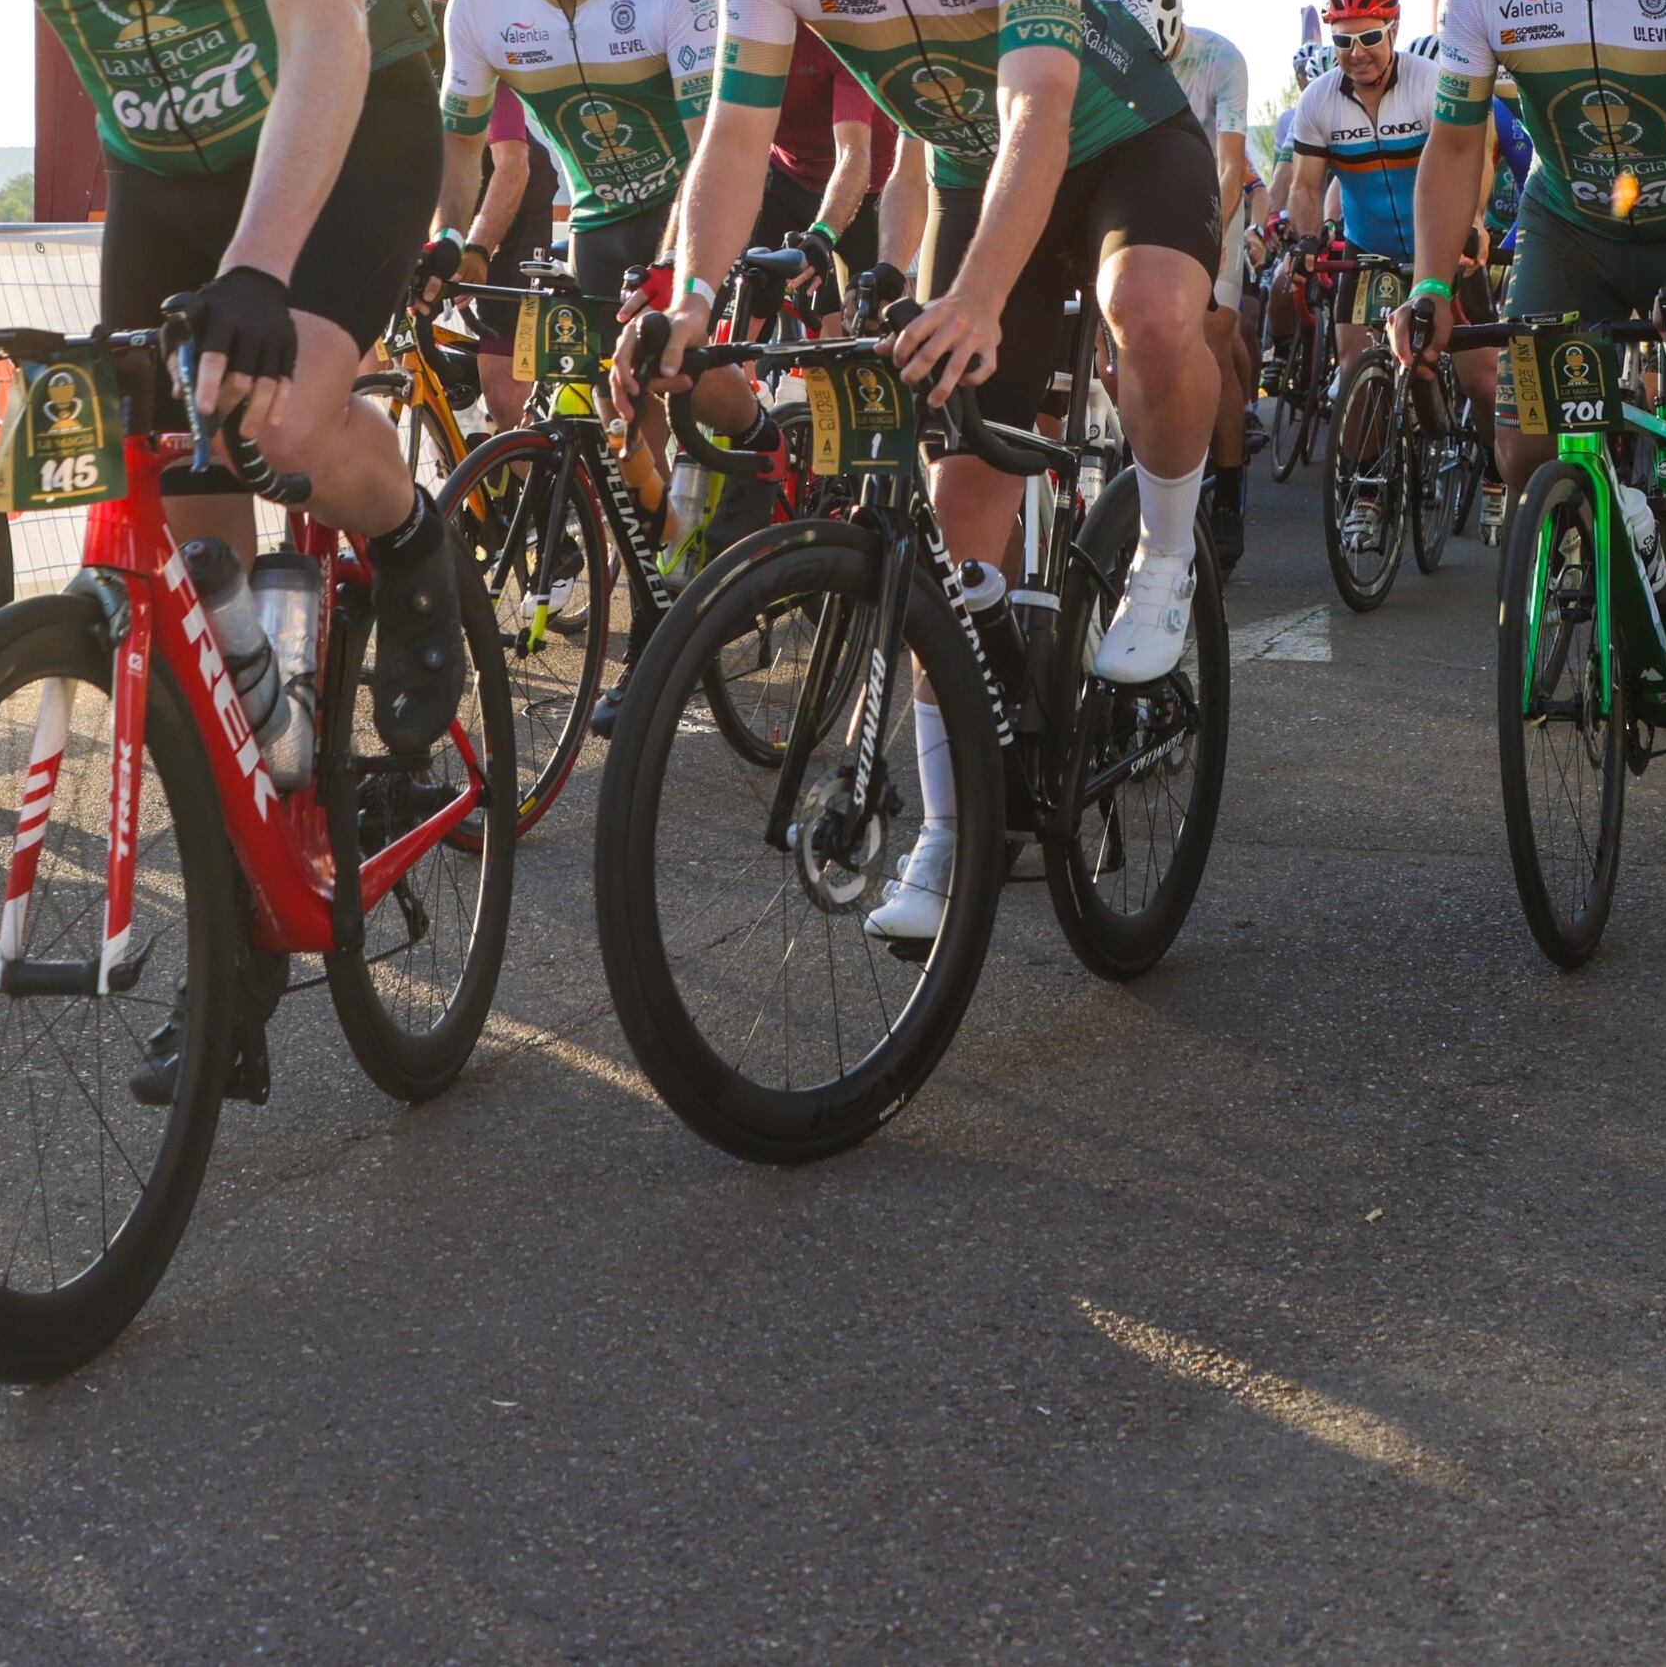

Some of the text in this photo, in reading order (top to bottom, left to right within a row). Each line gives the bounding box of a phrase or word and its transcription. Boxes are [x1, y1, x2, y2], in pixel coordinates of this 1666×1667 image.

[500, 25, 550, 45] Valentia
[1515, 24, 1558, 36] GOBIERNO
[1516, 33, 1527, 42] DE
[516, 50, 547, 61] GOBIERNO
[394, 330, 414, 348] 24
[560, 356, 574, 374] 9
[1561, 400, 1604, 423] 701
[871, 432, 882, 459] 1
[39, 454, 99, 492] 145
[597, 440, 670, 612] SPECIALIZED
[164, 548, 279, 822] TREK
[853, 648, 886, 807] SPECIALIZED
[1130, 729, 1188, 777] SPECIALIZED
[115, 741, 136, 862] TREK
